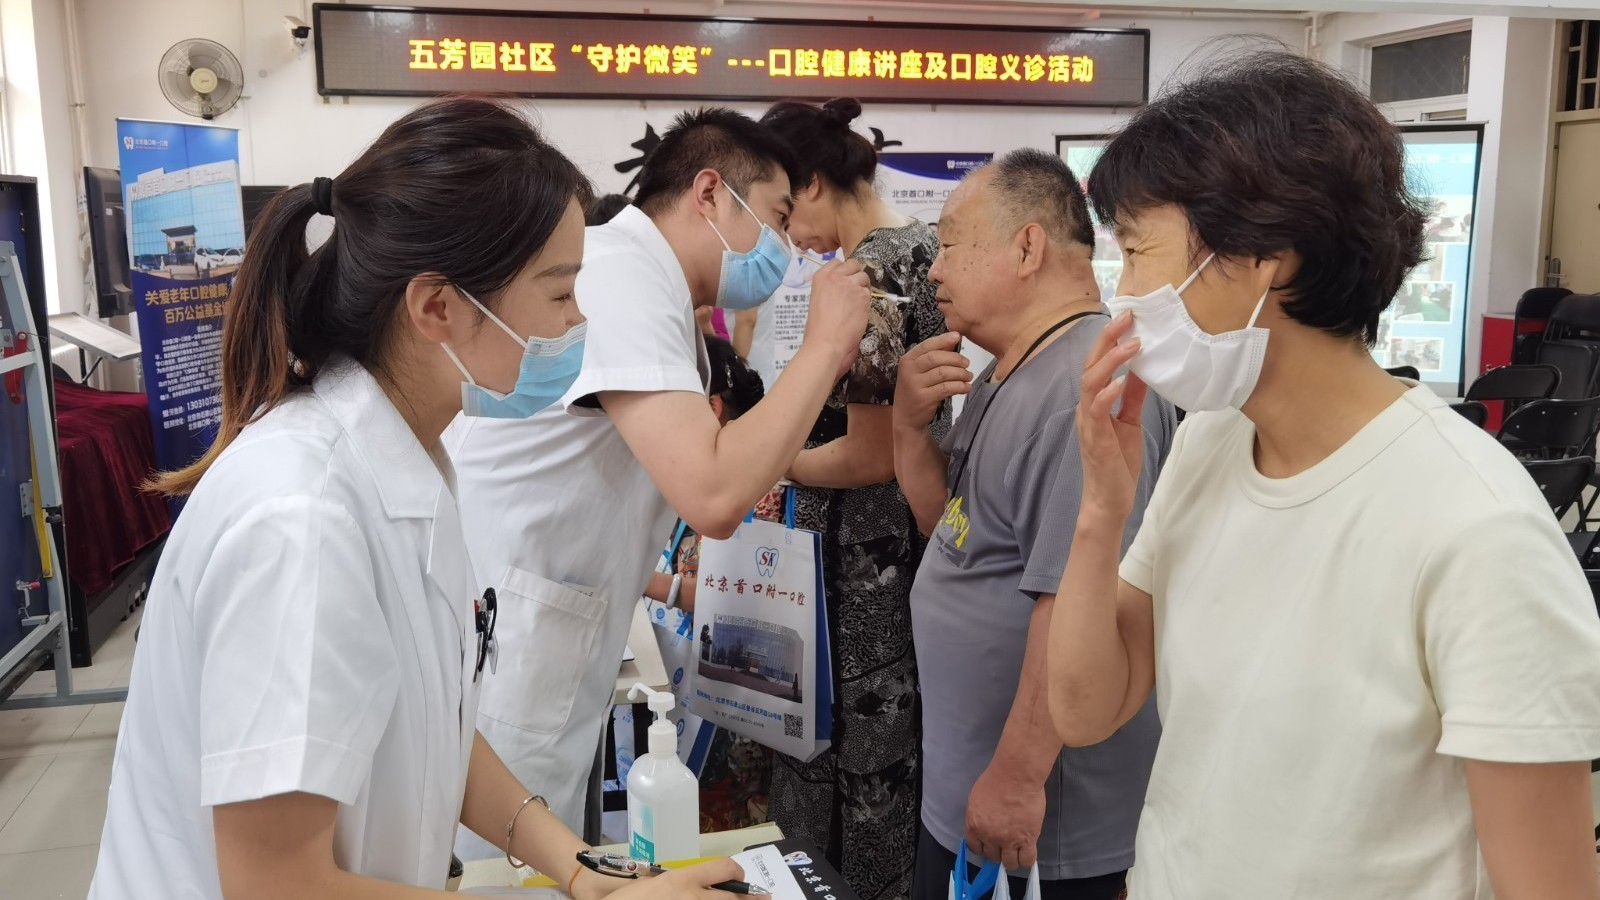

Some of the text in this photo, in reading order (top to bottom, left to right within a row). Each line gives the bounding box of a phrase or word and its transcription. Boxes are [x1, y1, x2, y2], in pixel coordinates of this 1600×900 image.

[892, 189, 954, 198] 北京首口附一口
[785, 294, 810, 302] 专家简
[704, 574, 805, 606] 北京首口附一口腔
